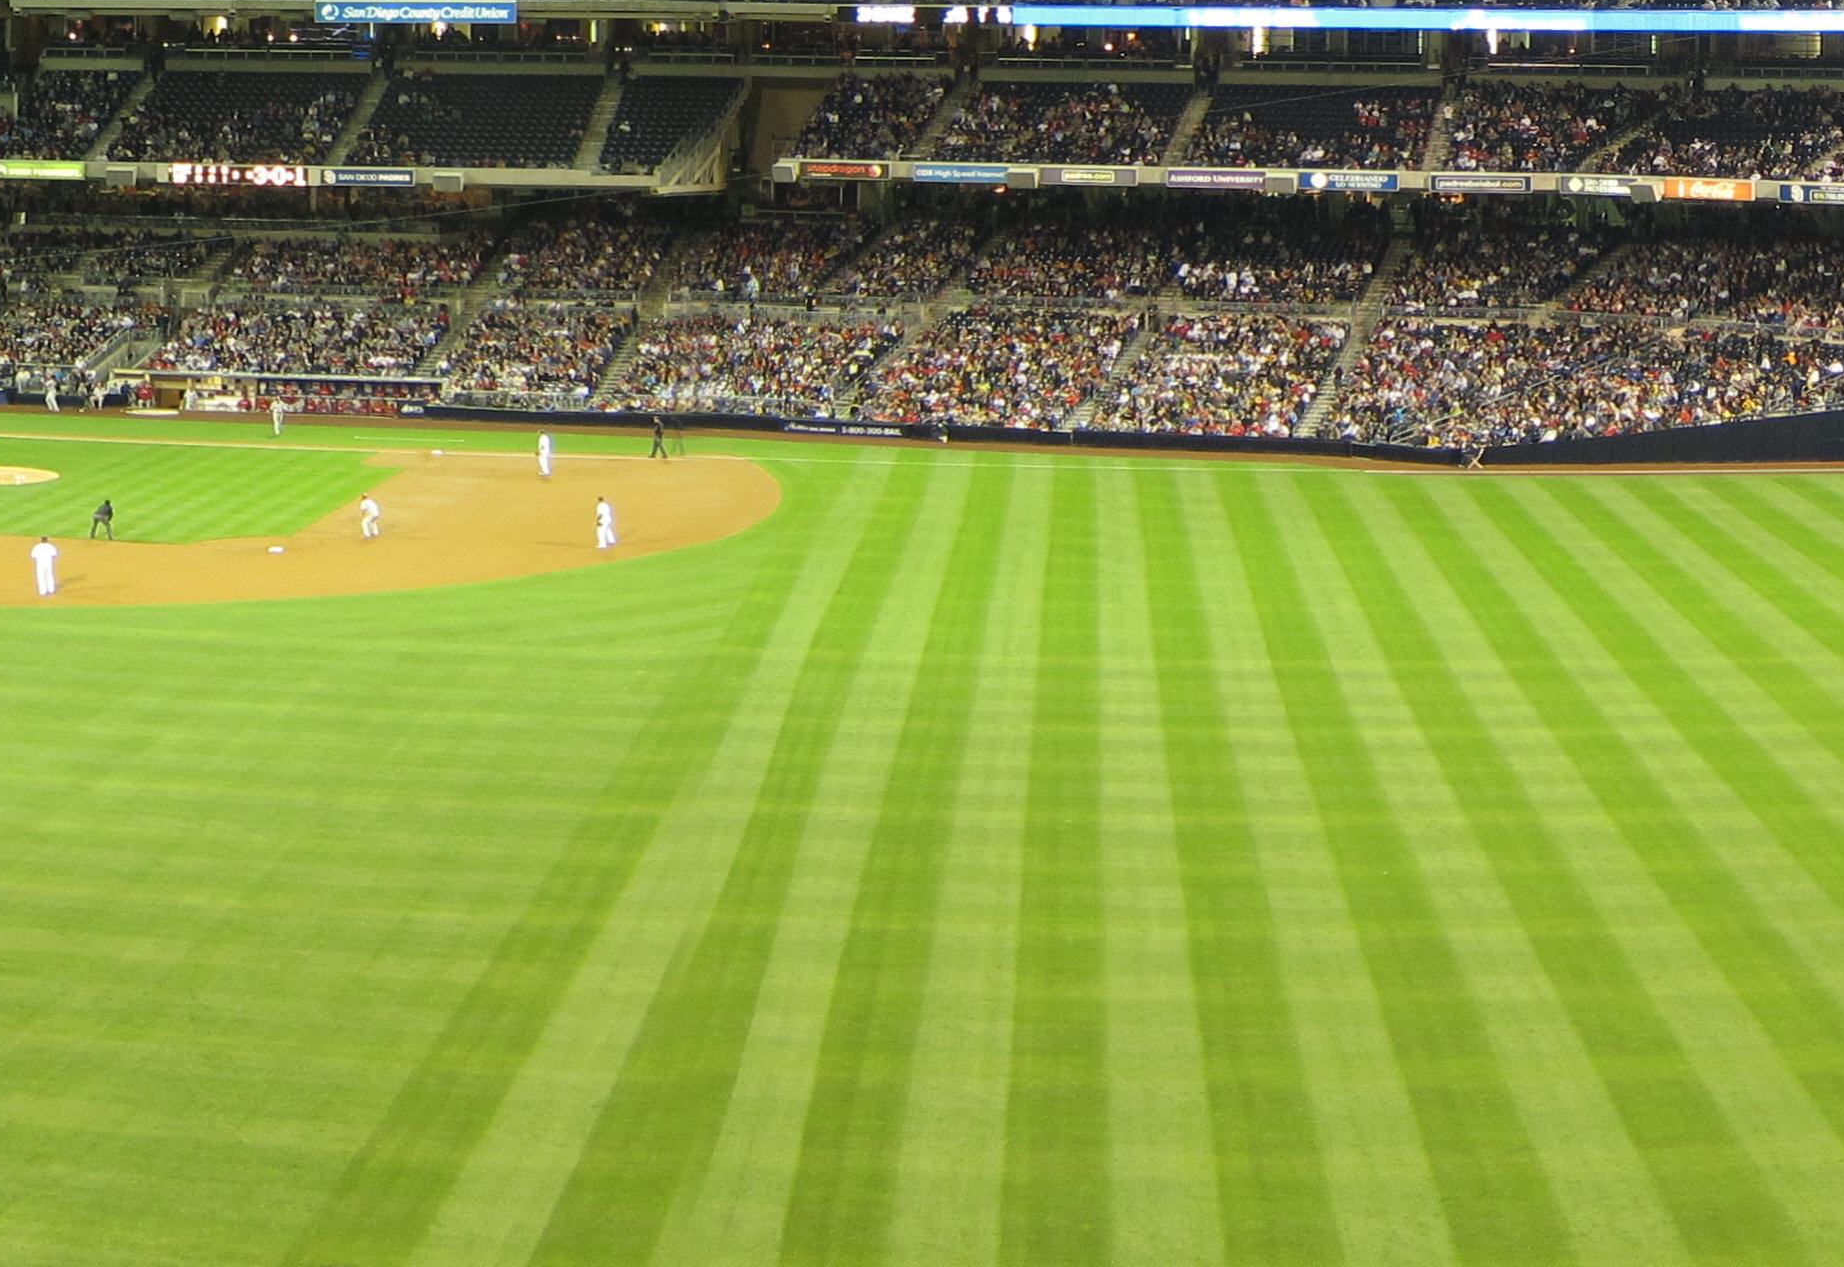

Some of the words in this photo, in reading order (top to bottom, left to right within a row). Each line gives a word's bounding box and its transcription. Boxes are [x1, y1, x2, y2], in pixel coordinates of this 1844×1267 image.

[343, 5, 366, 19] San
[367, 5, 399, 21] Diego
[400, 5, 440, 21] County
[441, 5, 475, 19] Credit
[475, 6, 510, 19] Union
[1169, 174, 1212, 184] ASHFORD
[1213, 175, 1264, 185] UNIVERSITY
